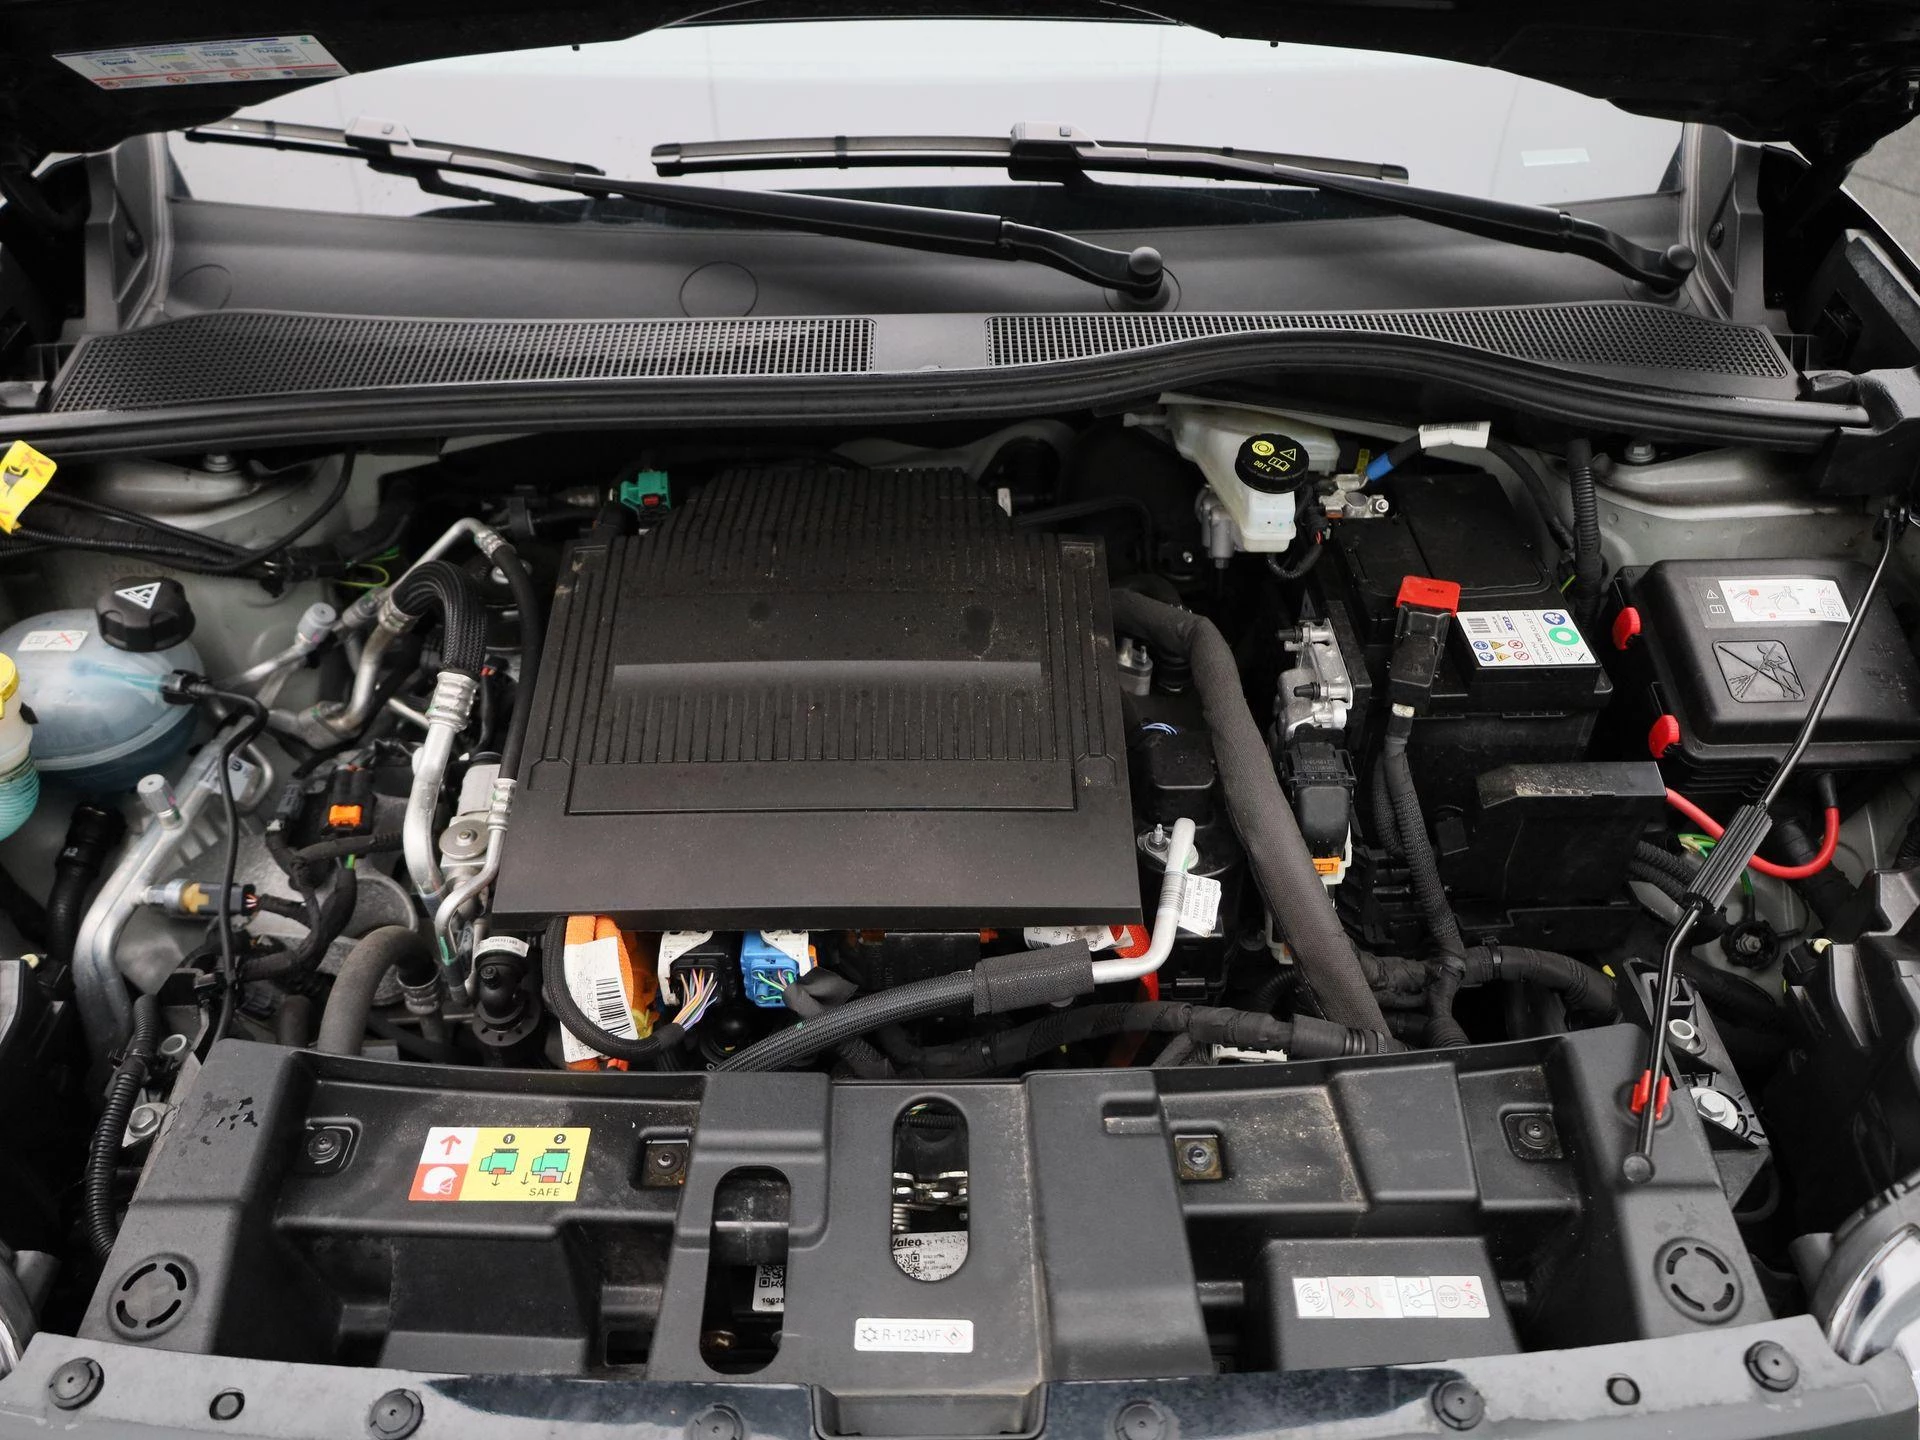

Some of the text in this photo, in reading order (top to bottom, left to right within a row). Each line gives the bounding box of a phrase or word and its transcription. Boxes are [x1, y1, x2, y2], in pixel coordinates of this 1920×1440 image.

[1253, 460, 1267, 470] DOT
[529, 1187, 560, 1197] SAFE
[882, 1327, 942, 1342] R-1234YF
